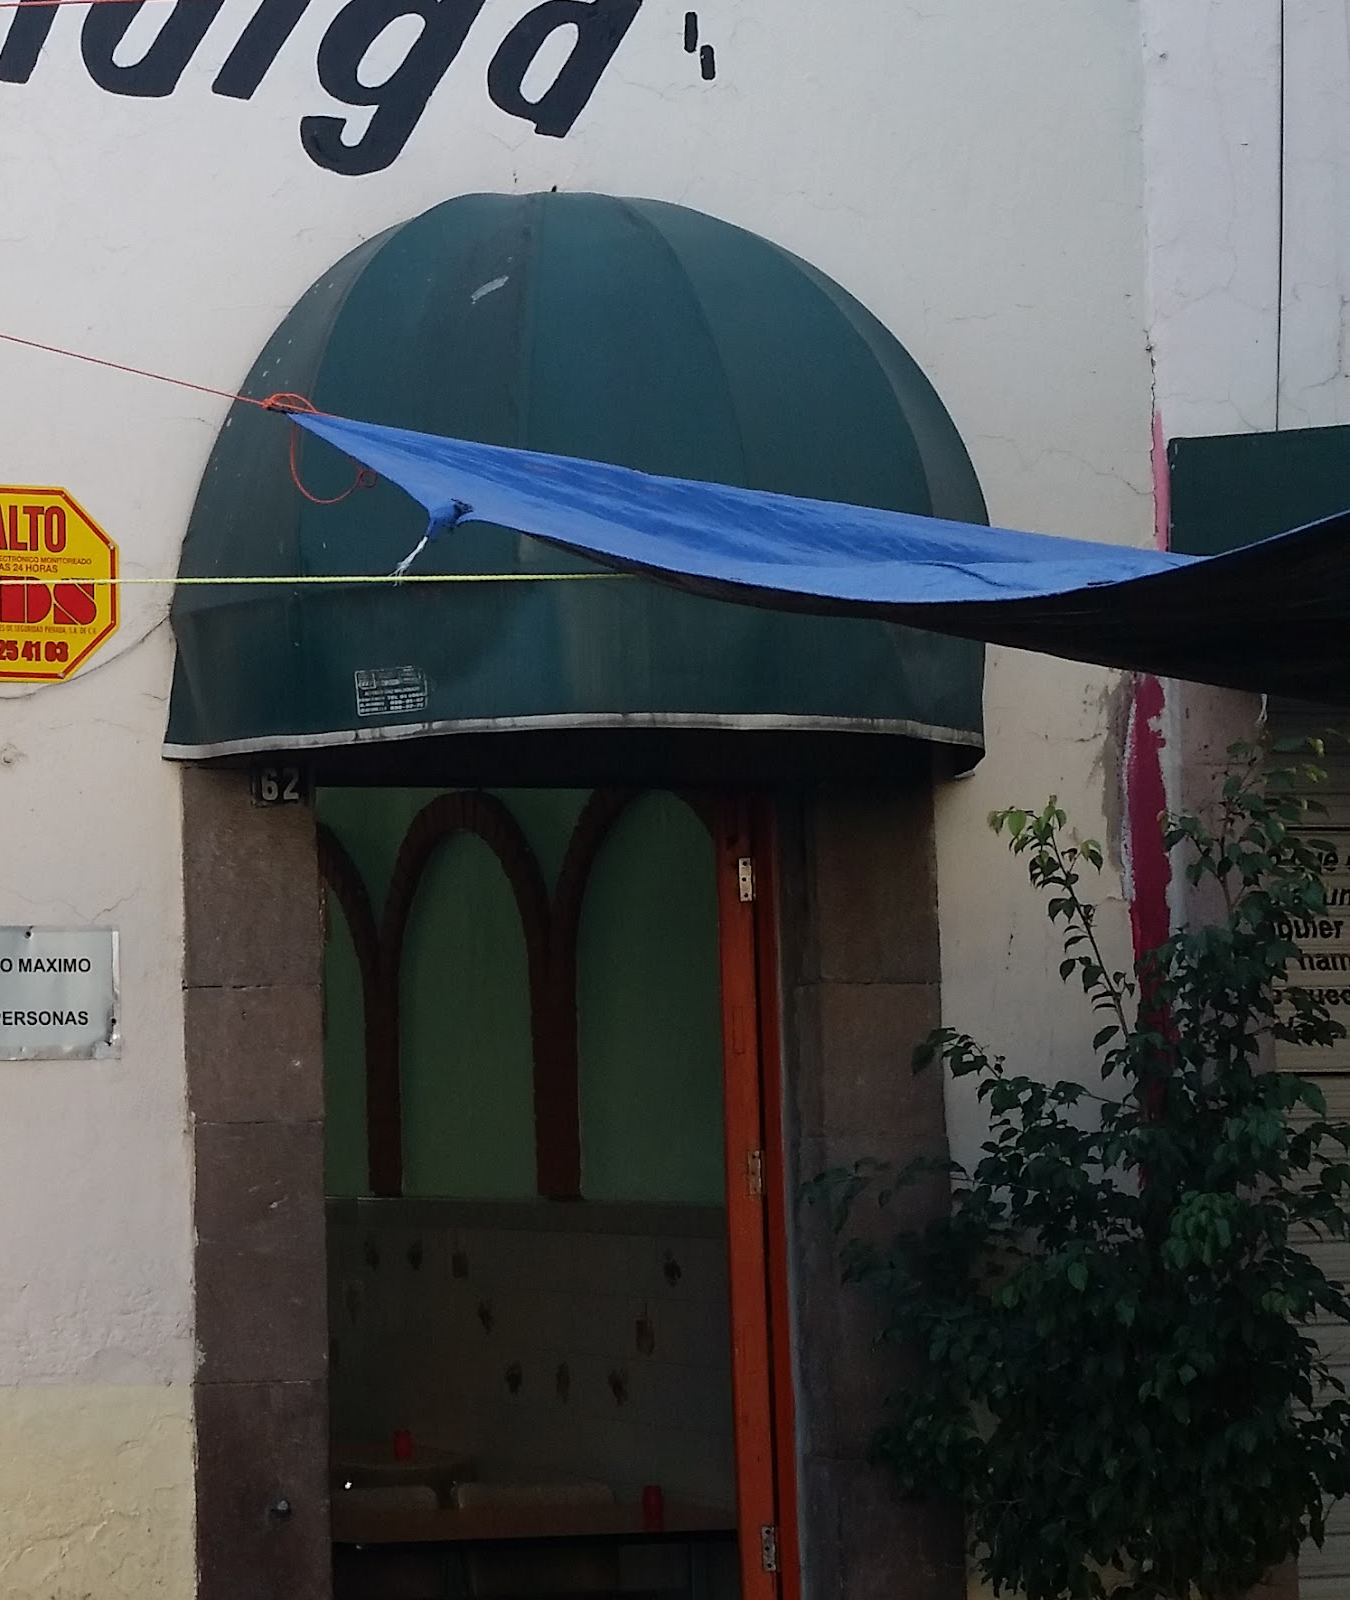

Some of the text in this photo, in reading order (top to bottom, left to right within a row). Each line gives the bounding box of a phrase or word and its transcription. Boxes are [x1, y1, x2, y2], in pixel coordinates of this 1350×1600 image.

[13, 563, 23, 572] 24
[25, 564, 58, 573] HORAS
[40, 556, 92, 565] MONITOREADO
[21, 641, 41, 662] 41
[261, 768, 299, 801] 62
[17, 957, 92, 973] MAXIMO
